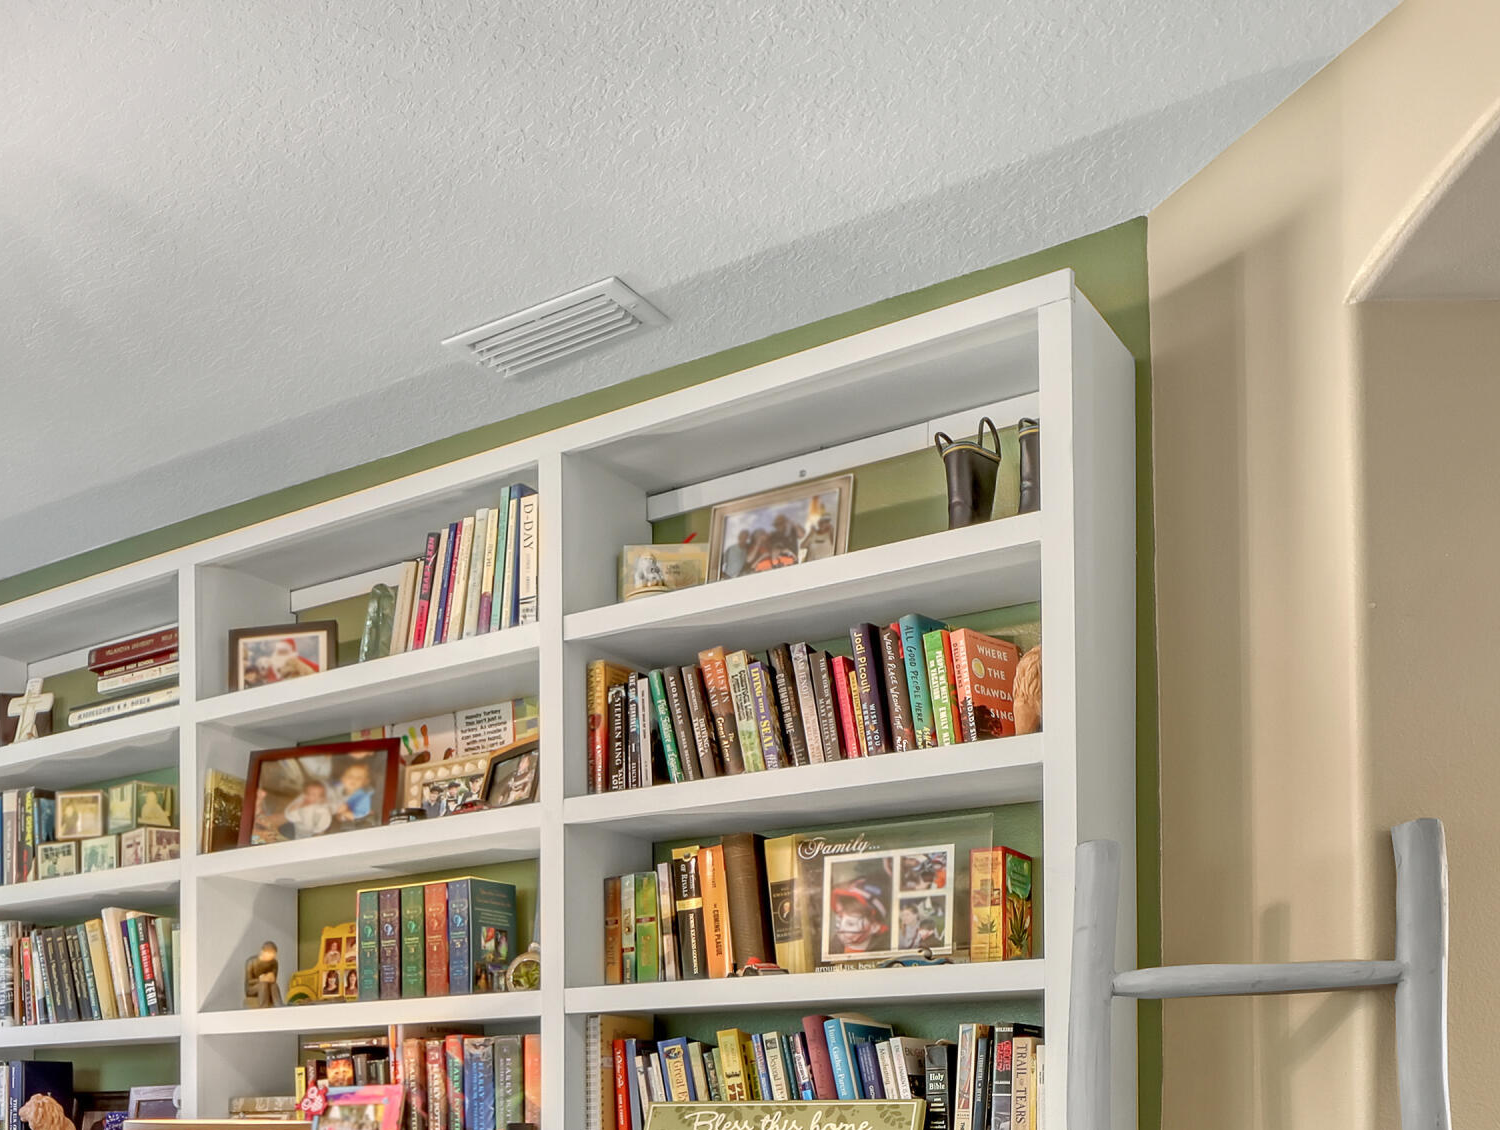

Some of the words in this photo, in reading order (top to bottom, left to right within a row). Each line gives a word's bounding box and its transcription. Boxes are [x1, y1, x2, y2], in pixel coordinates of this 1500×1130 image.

[522, 503, 536, 550] D-DAY
[422, 564, 434, 594] LEVEL
[853, 631, 865, 654] Jodi
[904, 625, 914, 641] ALL
[882, 633, 895, 661] WRONG
[906, 645, 918, 667] GOOD
[952, 643, 960, 662] DELIA
[957, 639, 967, 664] WHERE
[976, 644, 1008, 662] WHERE
[935, 650, 945, 674] PEOPLE
[713, 660, 731, 704] KRISTIN
[821, 673, 830, 696] WORDS
[858, 657, 871, 694] Picoult
[887, 663, 898, 685] PLACE
[910, 670, 922, 698] PEOPLE
[930, 668, 941, 700] VACATION
[939, 675, 947, 686] WE
[955, 664, 963, 688] OWENS
[961, 667, 970, 684] THE
[987, 667, 1006, 681] THE
[702, 664, 720, 708] HANNAH
[775, 673, 792, 713] COLUMBIA
[940, 687, 949, 703] MEET
[974, 684, 1013, 702] CRAWDA
[750, 667, 764, 697] LIVING
[759, 720, 774, 751] SEAL
[818, 698, 826, 716] MARY
[825, 699, 832, 710] WE
[889, 686, 902, 712] WRONG
[963, 685, 975, 726] CRAWDADS
[782, 713, 795, 734] HOME
[869, 704, 878, 725] WISH
[893, 714, 903, 730] TIME
[915, 702, 924, 722] HERE
[938, 706, 949, 729] EMILY
[990, 708, 1014, 721] SING
[698, 718, 711, 748] DRIVING
[715, 716, 728, 739] Great
[826, 711, 837, 742] WHISPER
[861, 702, 870, 726] WERE
[866, 730, 874, 751] HERE
[969, 728, 977, 741] SIN
[720, 739, 733, 763] Alone
[25, 791, 33, 813] WALT
[798, 833, 880, 860] Family...
[680, 864, 686, 872] OF
[681, 874, 689, 897] RIVALS
[712, 909, 721, 933] COMING
[714, 934, 723, 956] PLAGUE
[145, 982, 157, 1006] ZERO
[828, 1024, 838, 1045] Hunt,
[769, 1054, 780, 1081] Beyond
[831, 1045, 843, 1073] Gather,
[1016, 1044, 1028, 1078] TRAIL
[673, 1060, 685, 1085] Great
[929, 1073, 944, 1082] Holy
[836, 1073, 848, 1097] Parent
[929, 1082, 945, 1090] Bible
[1015, 1087, 1027, 1124] TEARS
